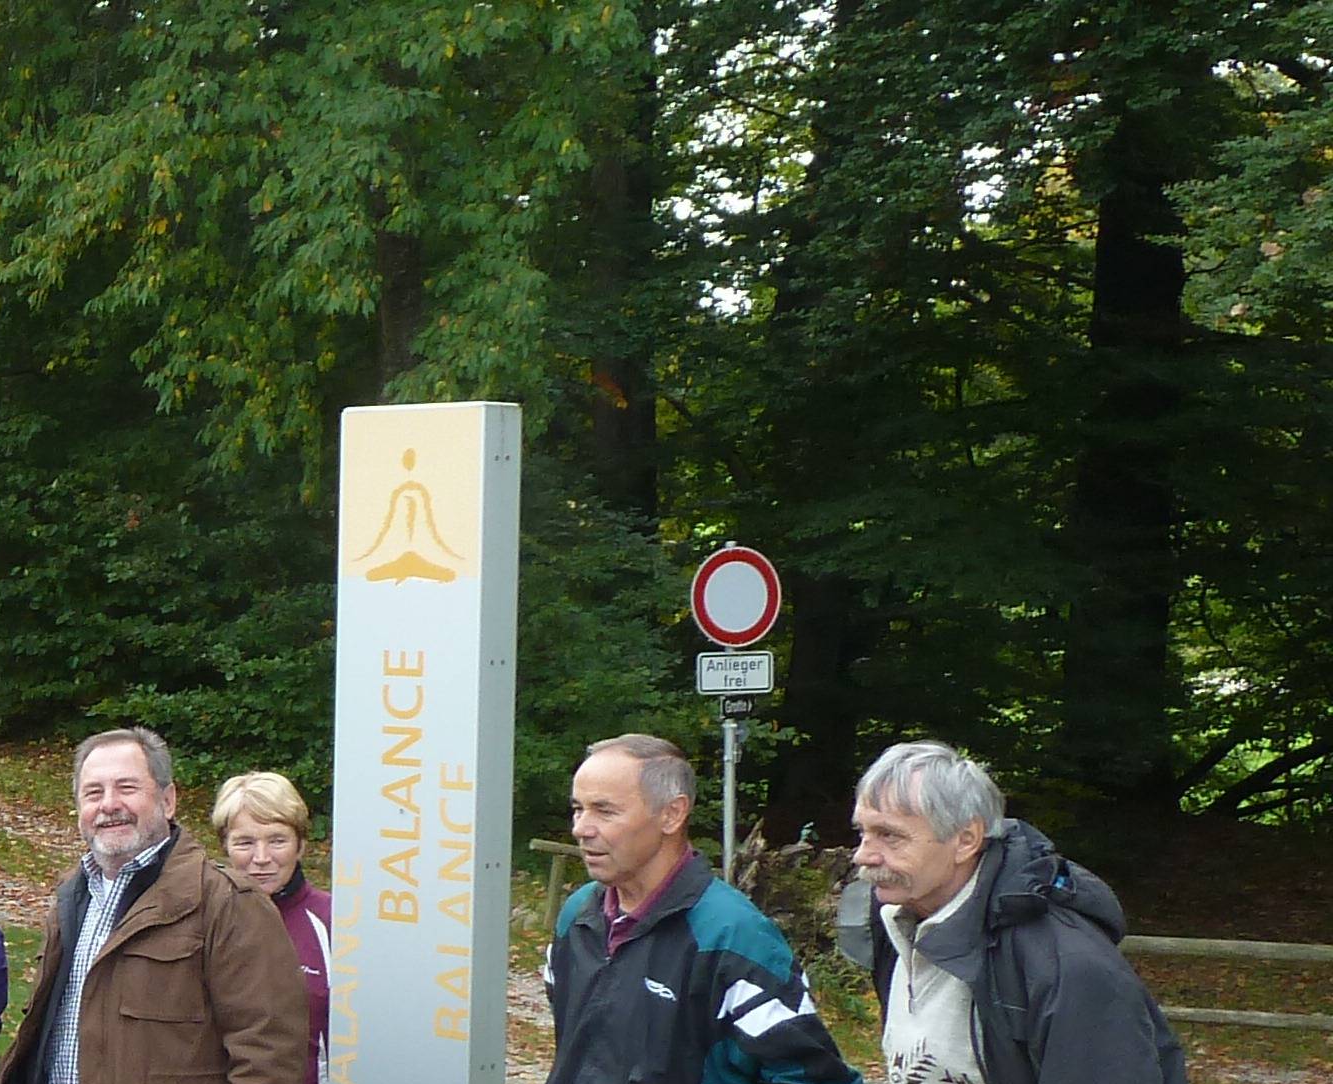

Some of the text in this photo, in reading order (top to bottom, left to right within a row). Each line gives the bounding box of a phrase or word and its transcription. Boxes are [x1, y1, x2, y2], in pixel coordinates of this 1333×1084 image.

[707, 659, 763, 673] Anlieger
[723, 674, 747, 688] frei
[377, 649, 426, 924] BALANCE
